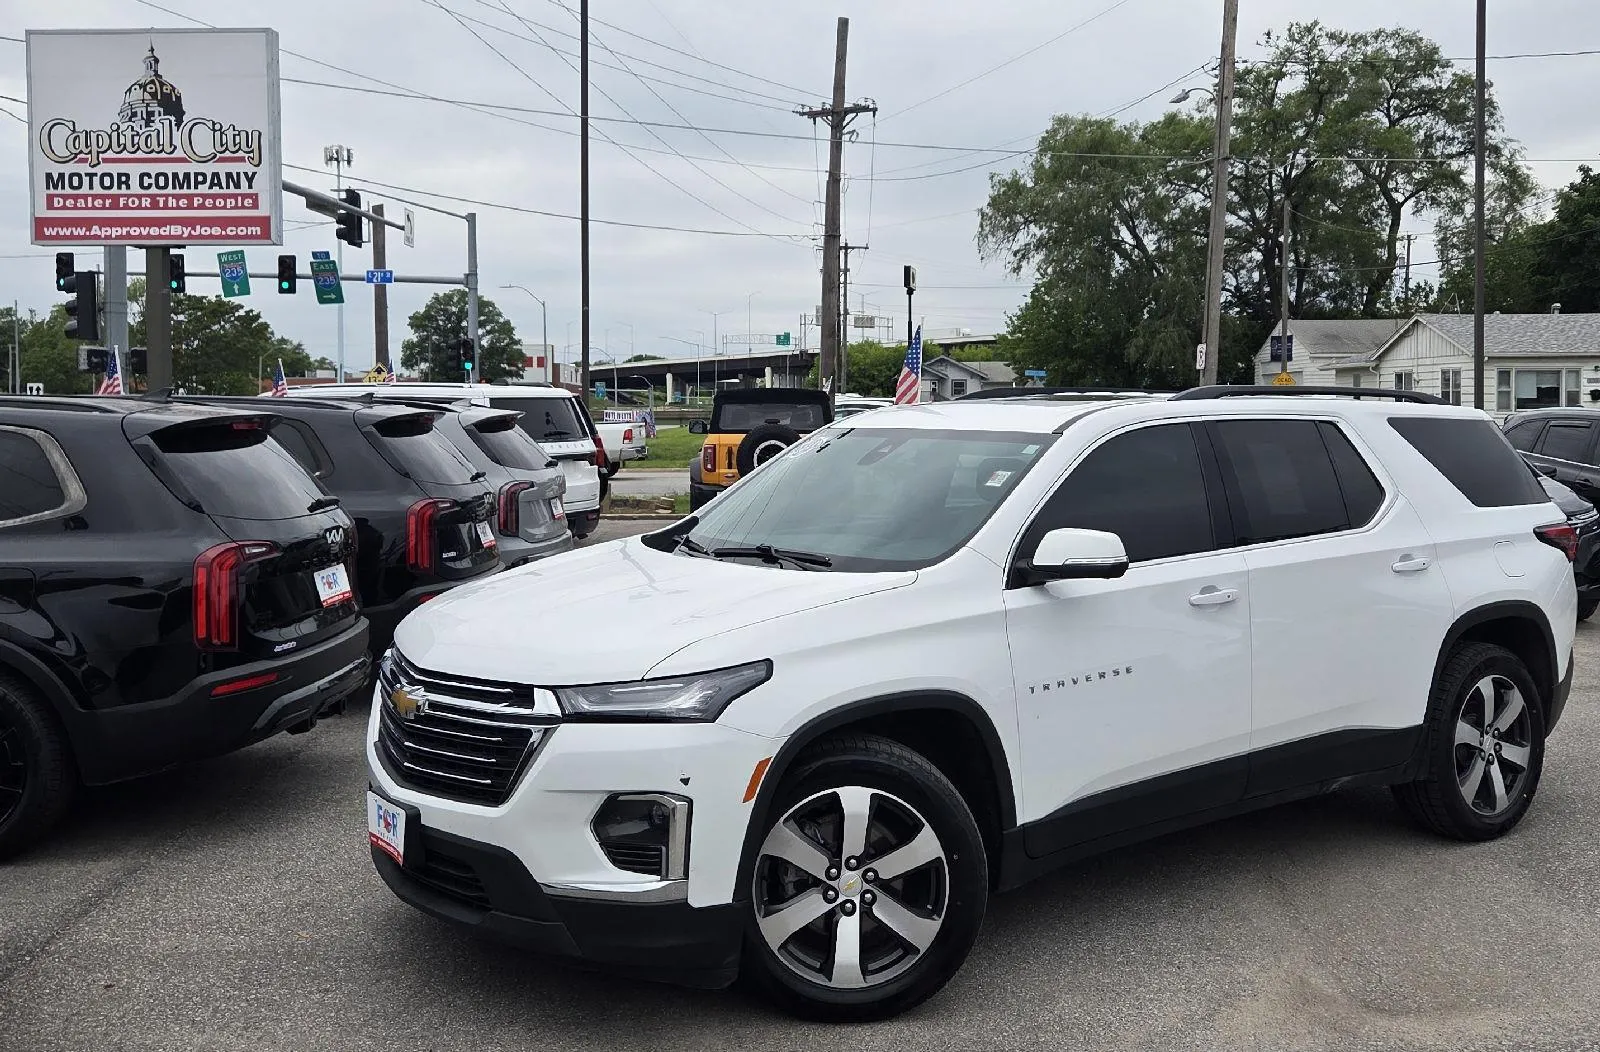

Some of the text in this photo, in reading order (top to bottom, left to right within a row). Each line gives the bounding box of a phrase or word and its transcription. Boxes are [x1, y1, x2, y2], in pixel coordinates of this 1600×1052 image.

[40, 118, 262, 167] Capital City
[45, 171, 257, 190] MOTOR COMPANY
[54, 197, 112, 208] Dealer
[119, 197, 151, 208] FOR
[156, 197, 188, 208] The
[44, 225, 261, 238] www.ApprovedByJoe.com
[220, 254, 242, 262] WEST
[225, 267, 243, 277] 235
[317, 277, 336, 285] 235
[1029, 666, 1133, 695] TRAVERSE
